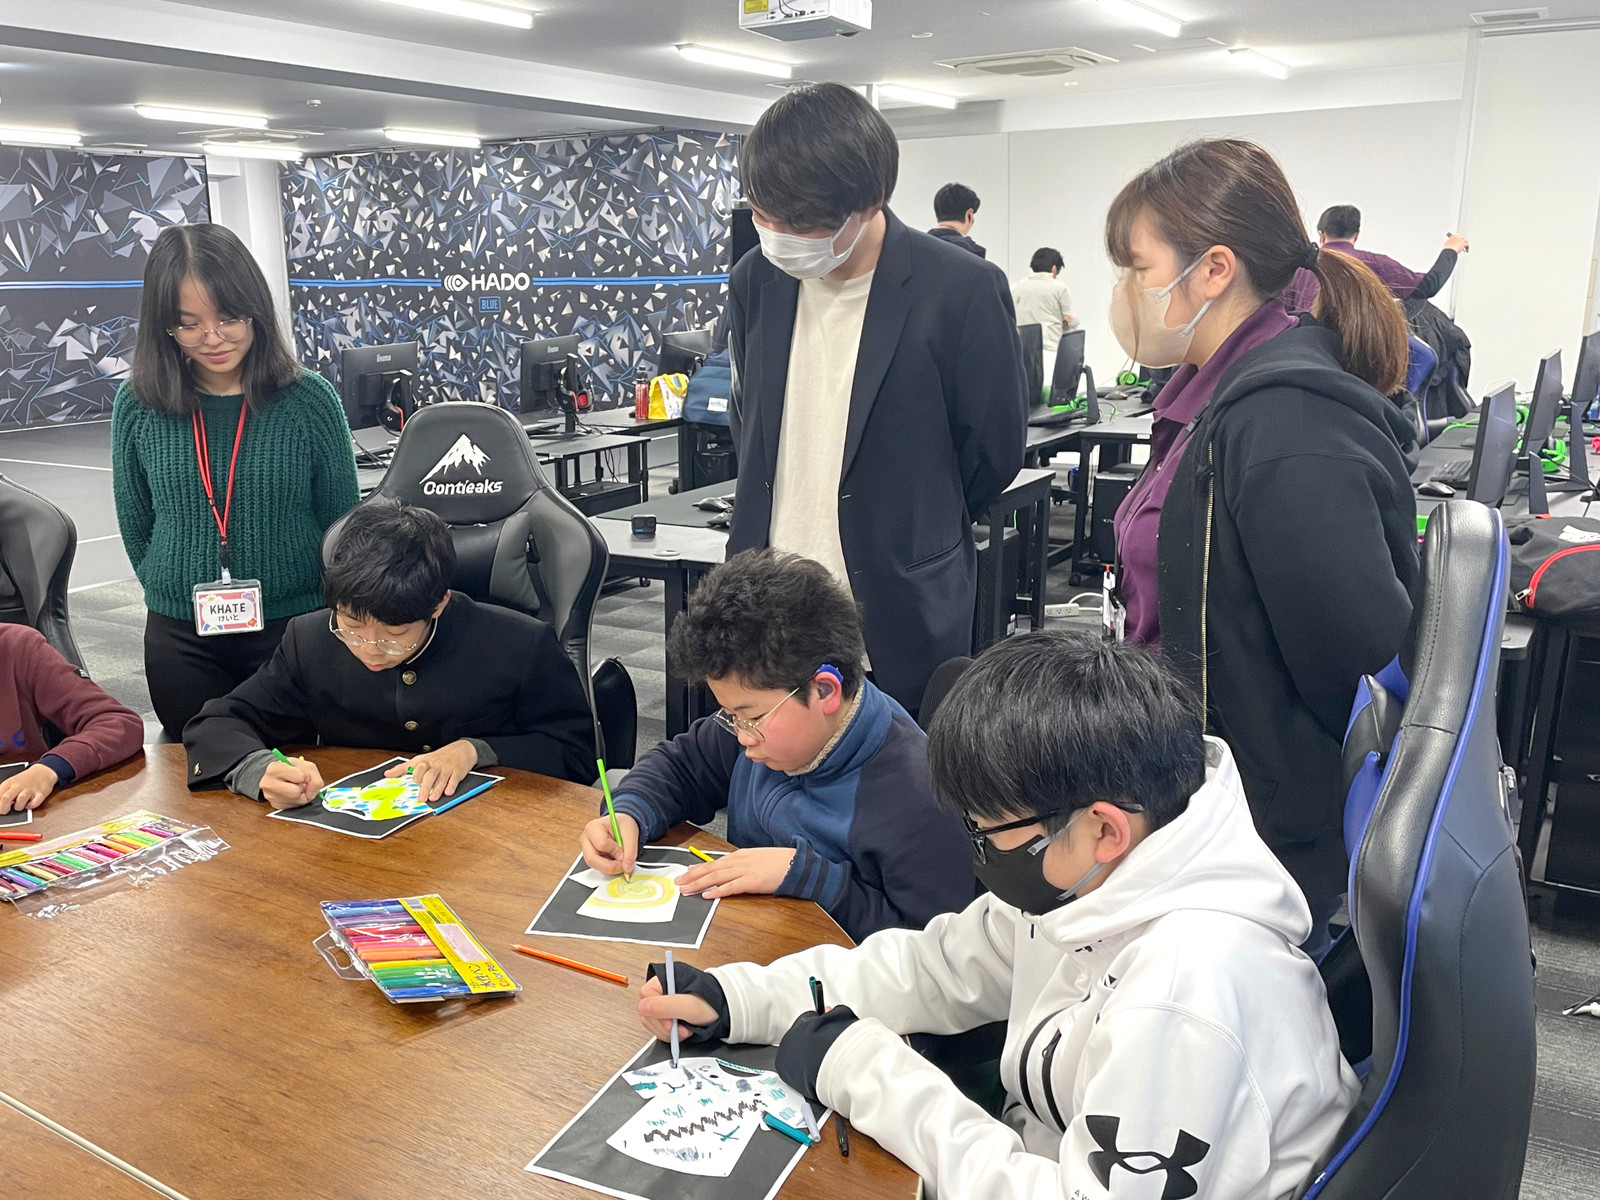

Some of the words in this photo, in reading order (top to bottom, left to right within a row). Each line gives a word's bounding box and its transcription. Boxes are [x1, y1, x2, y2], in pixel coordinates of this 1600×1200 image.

[471, 272, 530, 291] HADO
[481, 299, 498, 310] BLUE
[210, 603, 246, 615] KHATE
[218, 614, 239, 623] けいと
